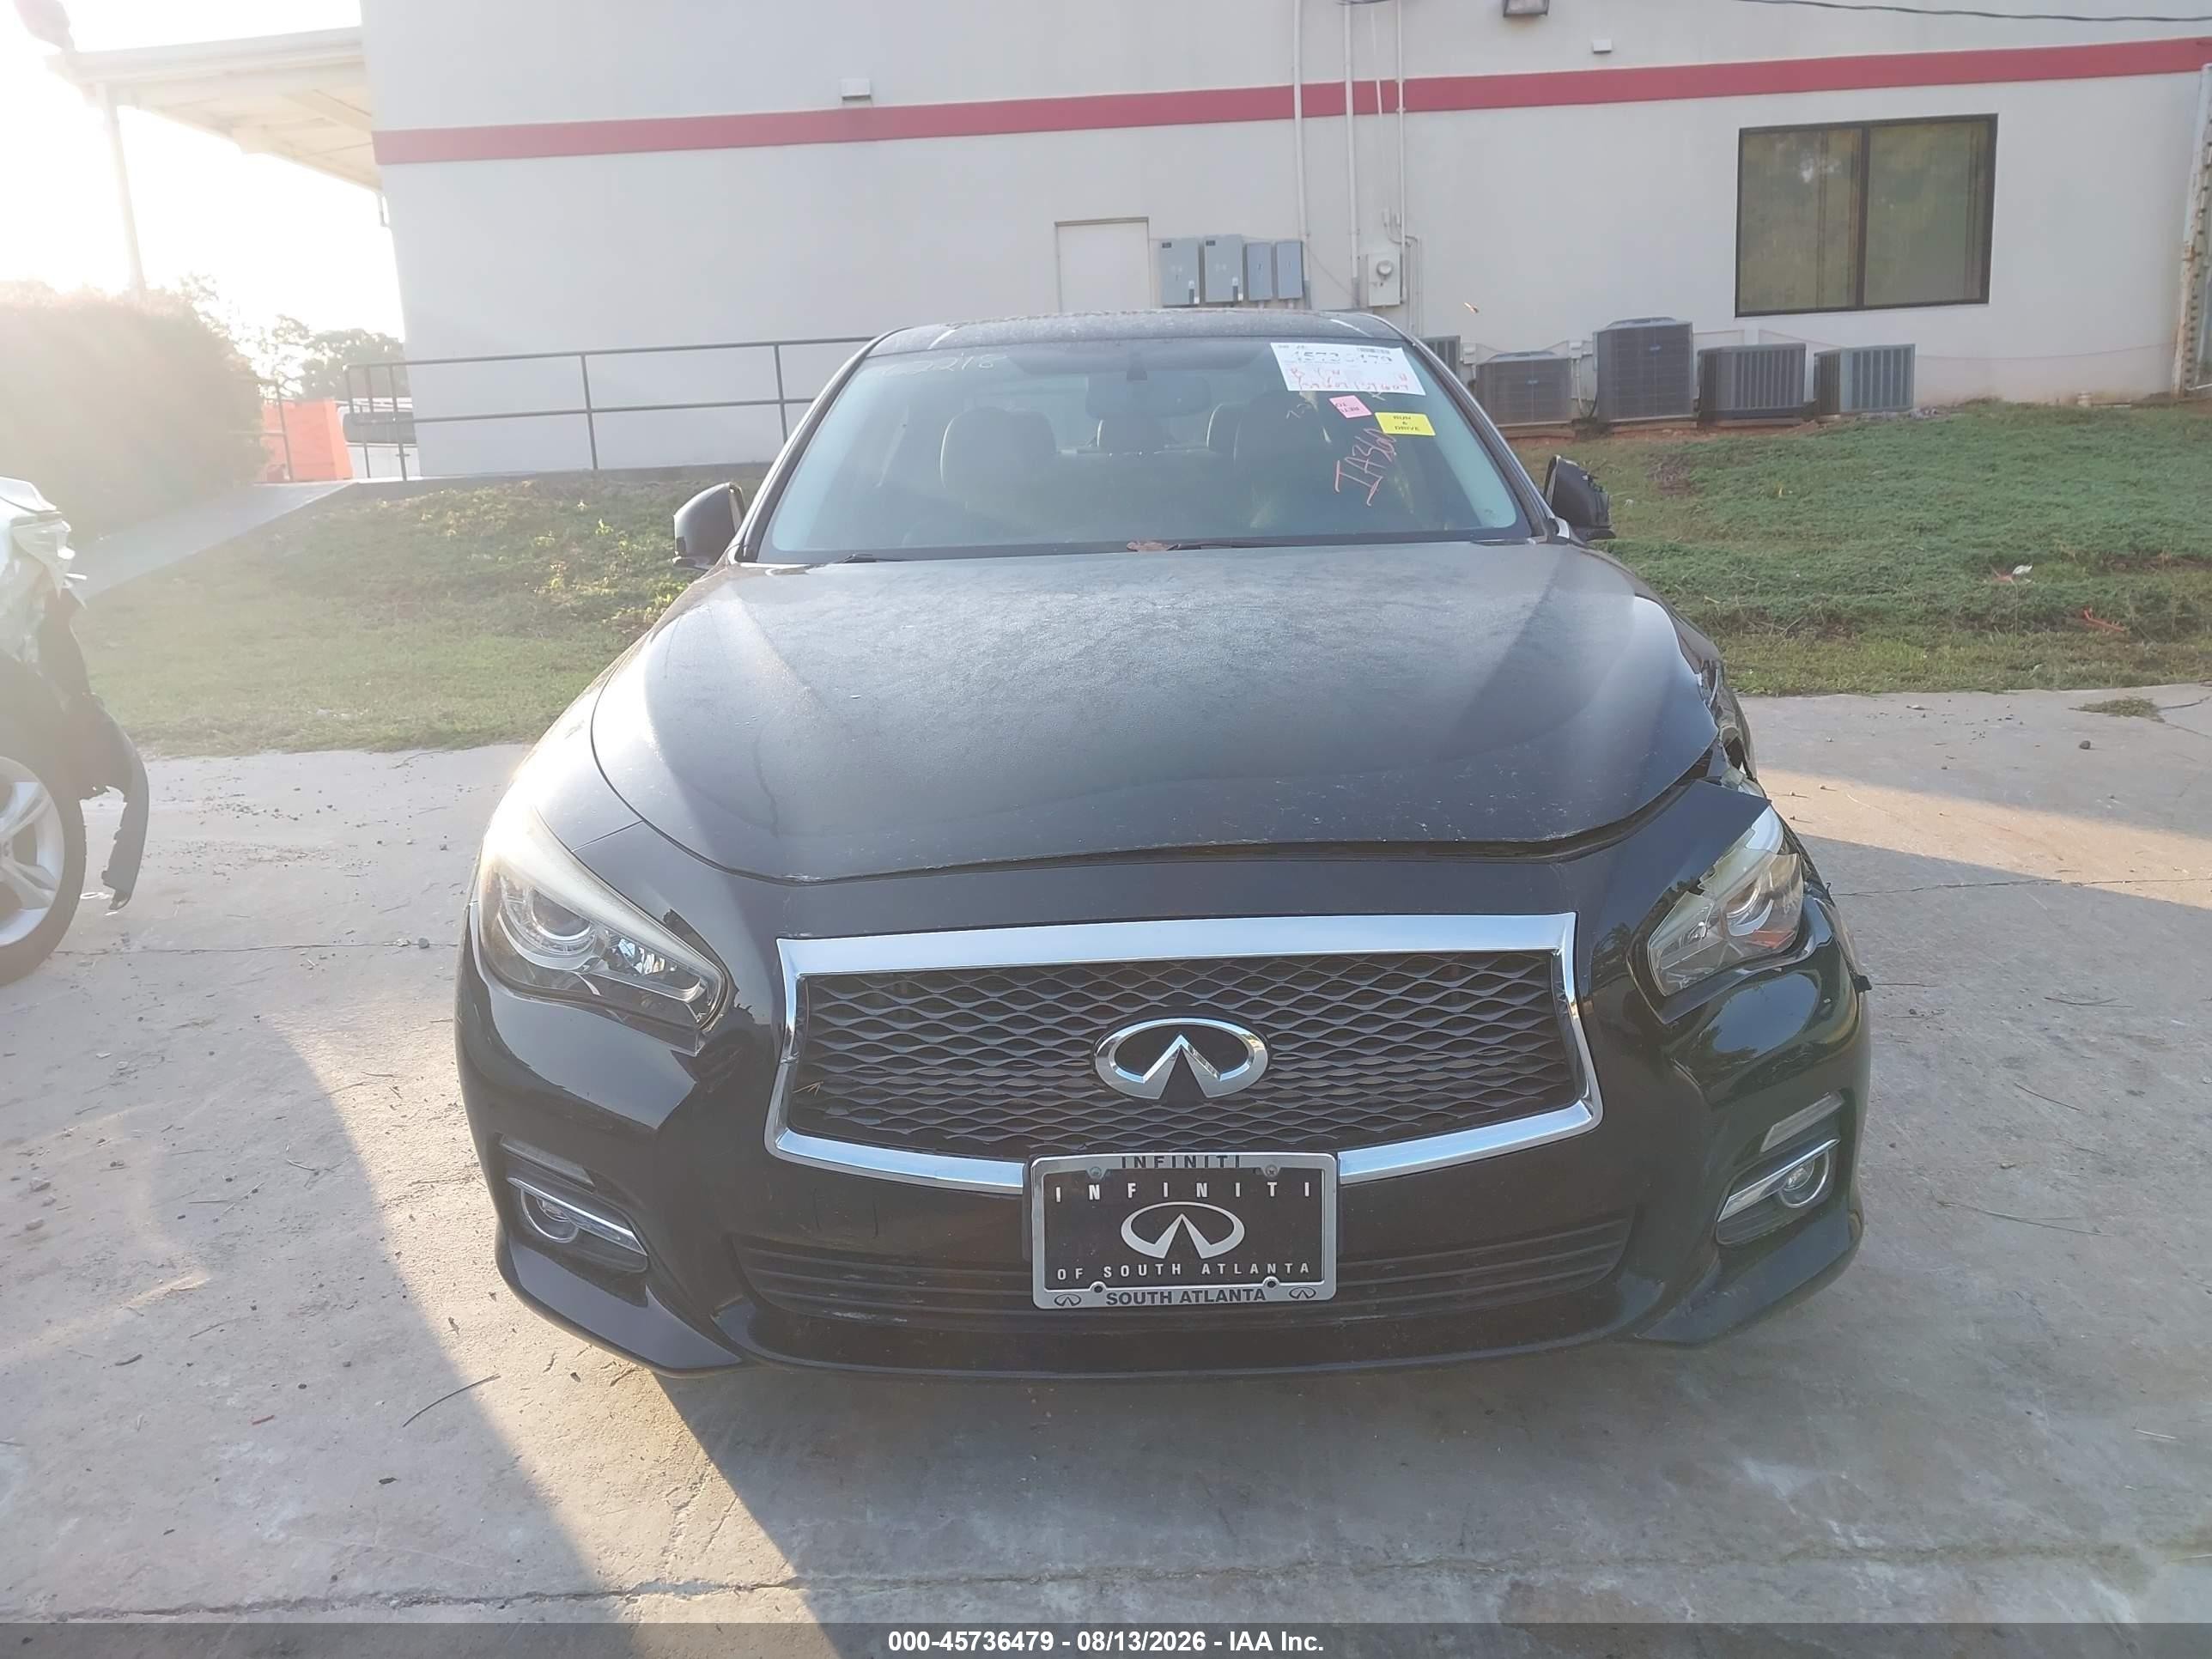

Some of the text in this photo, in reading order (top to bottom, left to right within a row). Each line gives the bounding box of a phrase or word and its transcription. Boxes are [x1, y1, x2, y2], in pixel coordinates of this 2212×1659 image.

[1121, 1154, 1243, 1170] INFINITI
[1055, 1182, 1310, 1203] INFINITI
[1057, 1261, 1310, 1280] OF SOUTH ATLANTA
[1106, 1288, 1267, 1306] SOUTH ATLANTA
